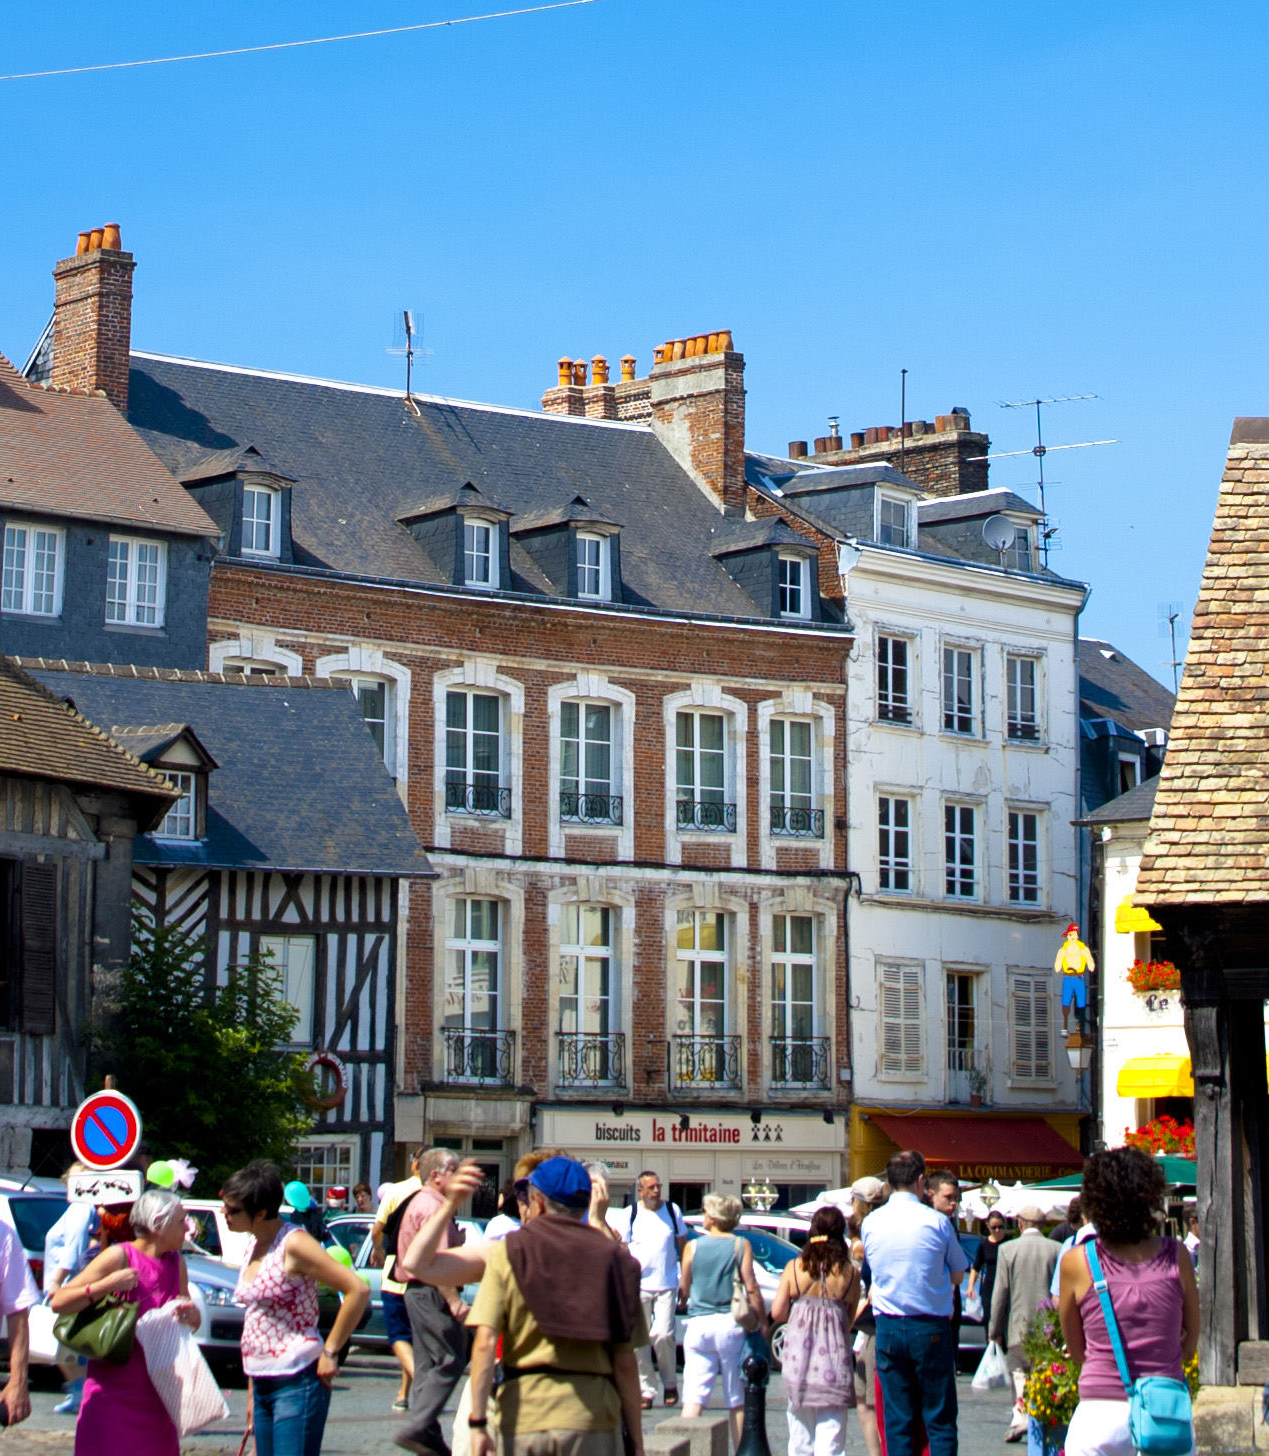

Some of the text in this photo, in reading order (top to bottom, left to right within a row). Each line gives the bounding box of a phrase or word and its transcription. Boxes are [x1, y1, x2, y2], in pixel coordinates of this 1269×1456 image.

[595, 1117, 741, 1144] biscuits la trinitaine
[960, 1165, 973, 1178] LA
[975, 1165, 1051, 1178] COMMANDERIE
